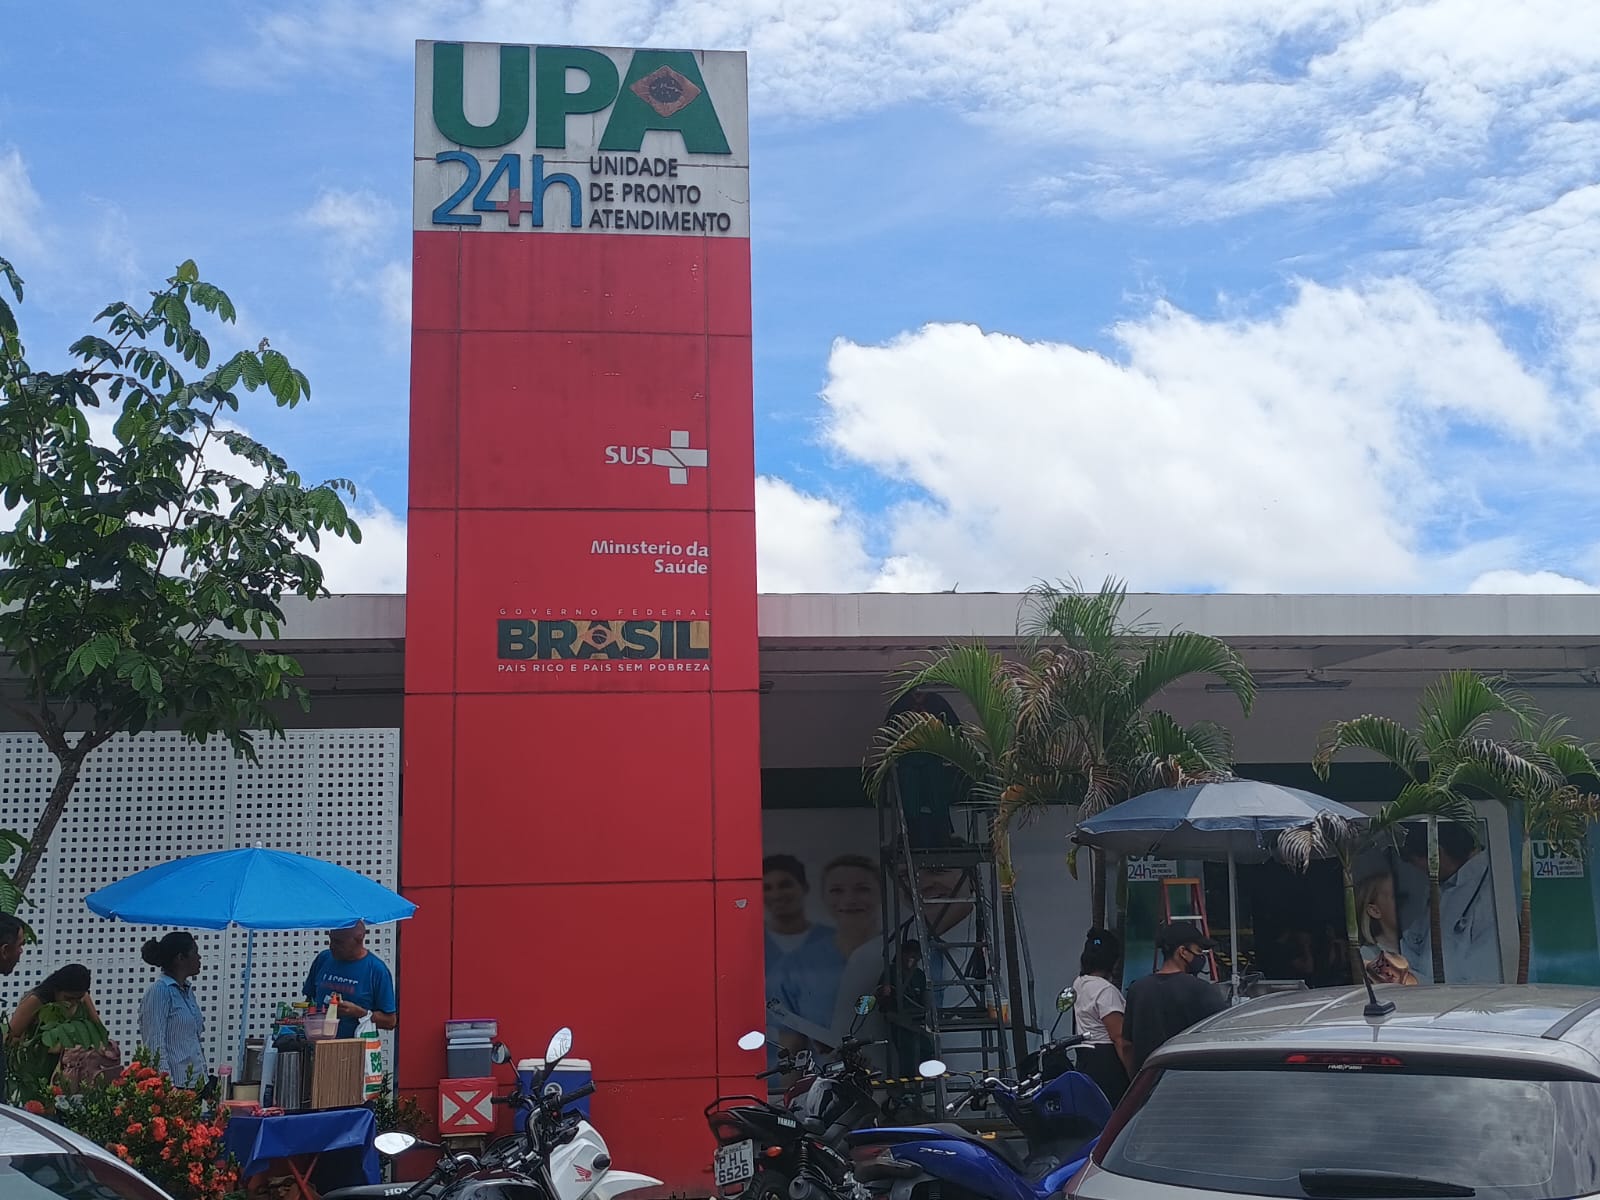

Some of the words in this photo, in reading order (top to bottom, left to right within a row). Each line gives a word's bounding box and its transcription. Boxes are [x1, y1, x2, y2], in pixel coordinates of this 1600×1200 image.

[432, 42, 732, 154] UPA
[590, 155, 678, 178] UNIDADE
[432, 151, 582, 227] 24h
[589, 183, 614, 201] DE
[622, 184, 701, 204] PRONTO
[589, 208, 731, 232] ATENDIMENTO
[605, 445, 651, 465] SUS
[686, 541, 709, 557] da
[654, 558, 708, 574] Saúde
[499, 608, 598, 616] GOVERNO
[617, 608, 710, 616] FEDERAL
[497, 619, 710, 660] BRASIL
[532, 664, 564, 672] RICO
[570, 664, 577, 672] E
[618, 664, 643, 672] SEM
[649, 663, 710, 672] POBREZA
[1127, 863, 1152, 879] 24h
[1536, 861, 1559, 876] 24h
[718, 1152, 747, 1170] PHL
[718, 1163, 749, 1184] 6526
